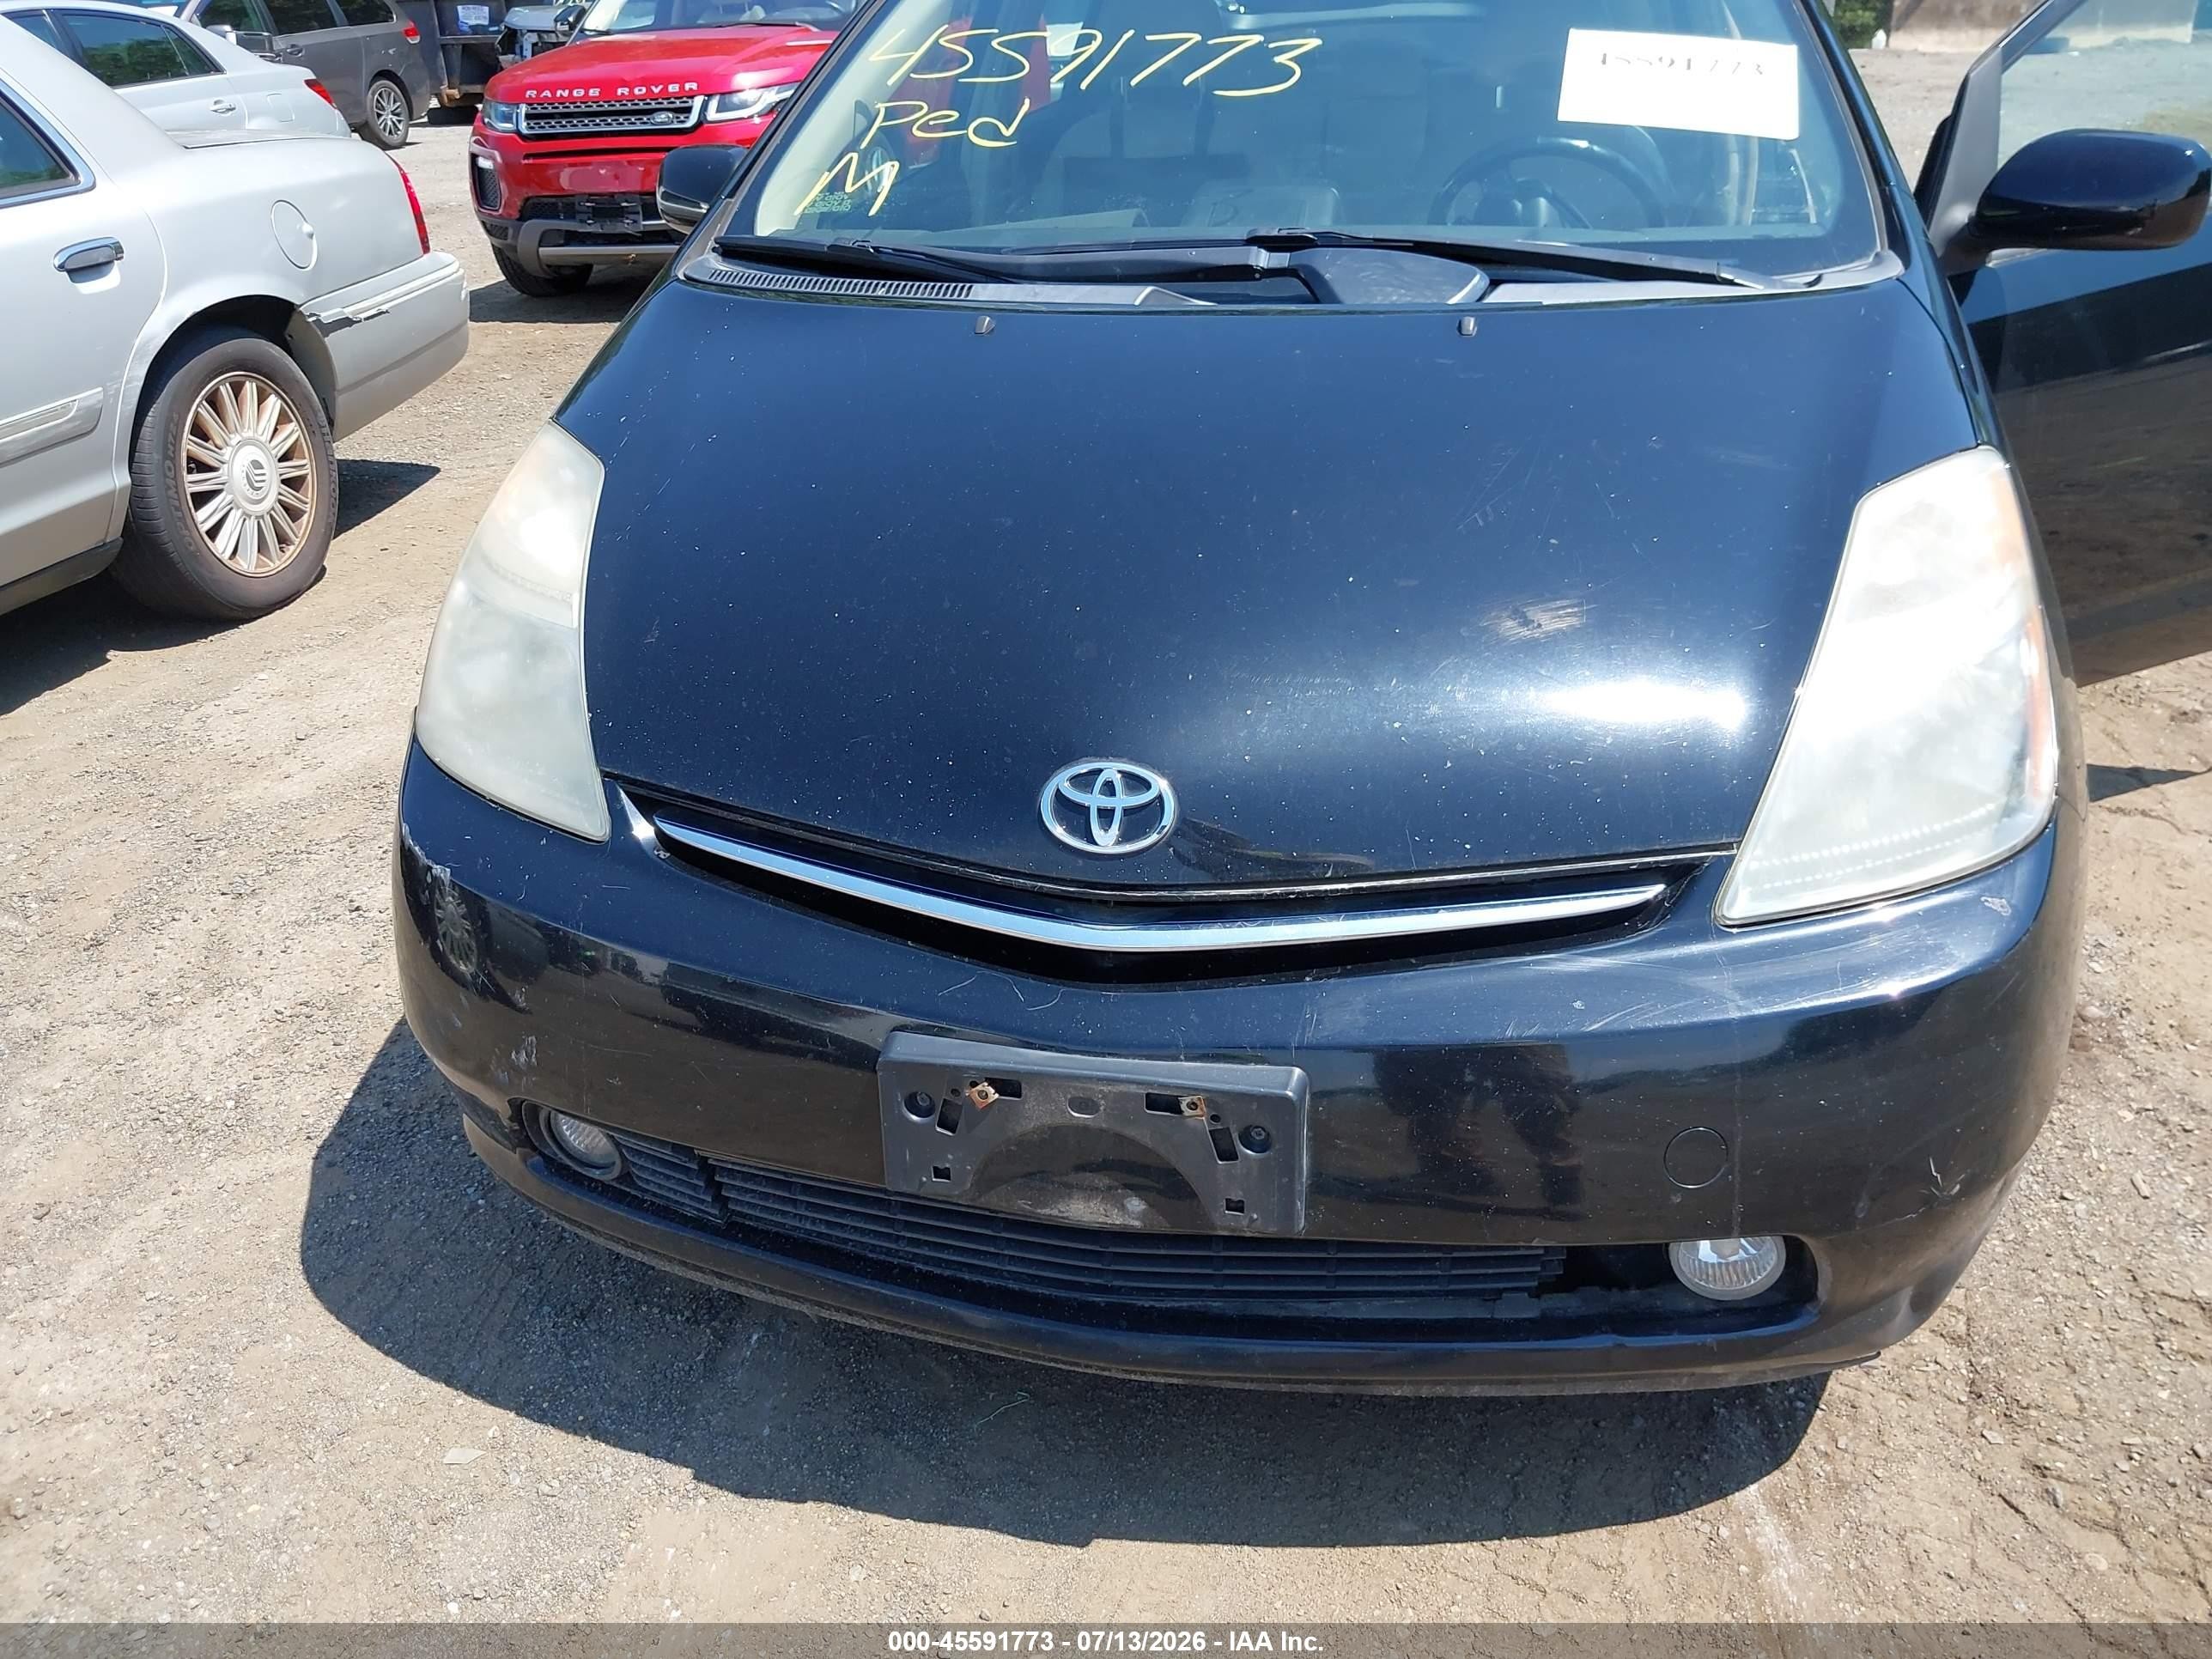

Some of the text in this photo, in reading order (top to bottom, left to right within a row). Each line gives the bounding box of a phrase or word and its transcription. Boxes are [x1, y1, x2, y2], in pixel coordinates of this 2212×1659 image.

[525, 82, 699, 99] RANGE ROVER
[870, 24, 1323, 97] 45591773
[793, 152, 900, 216] M
